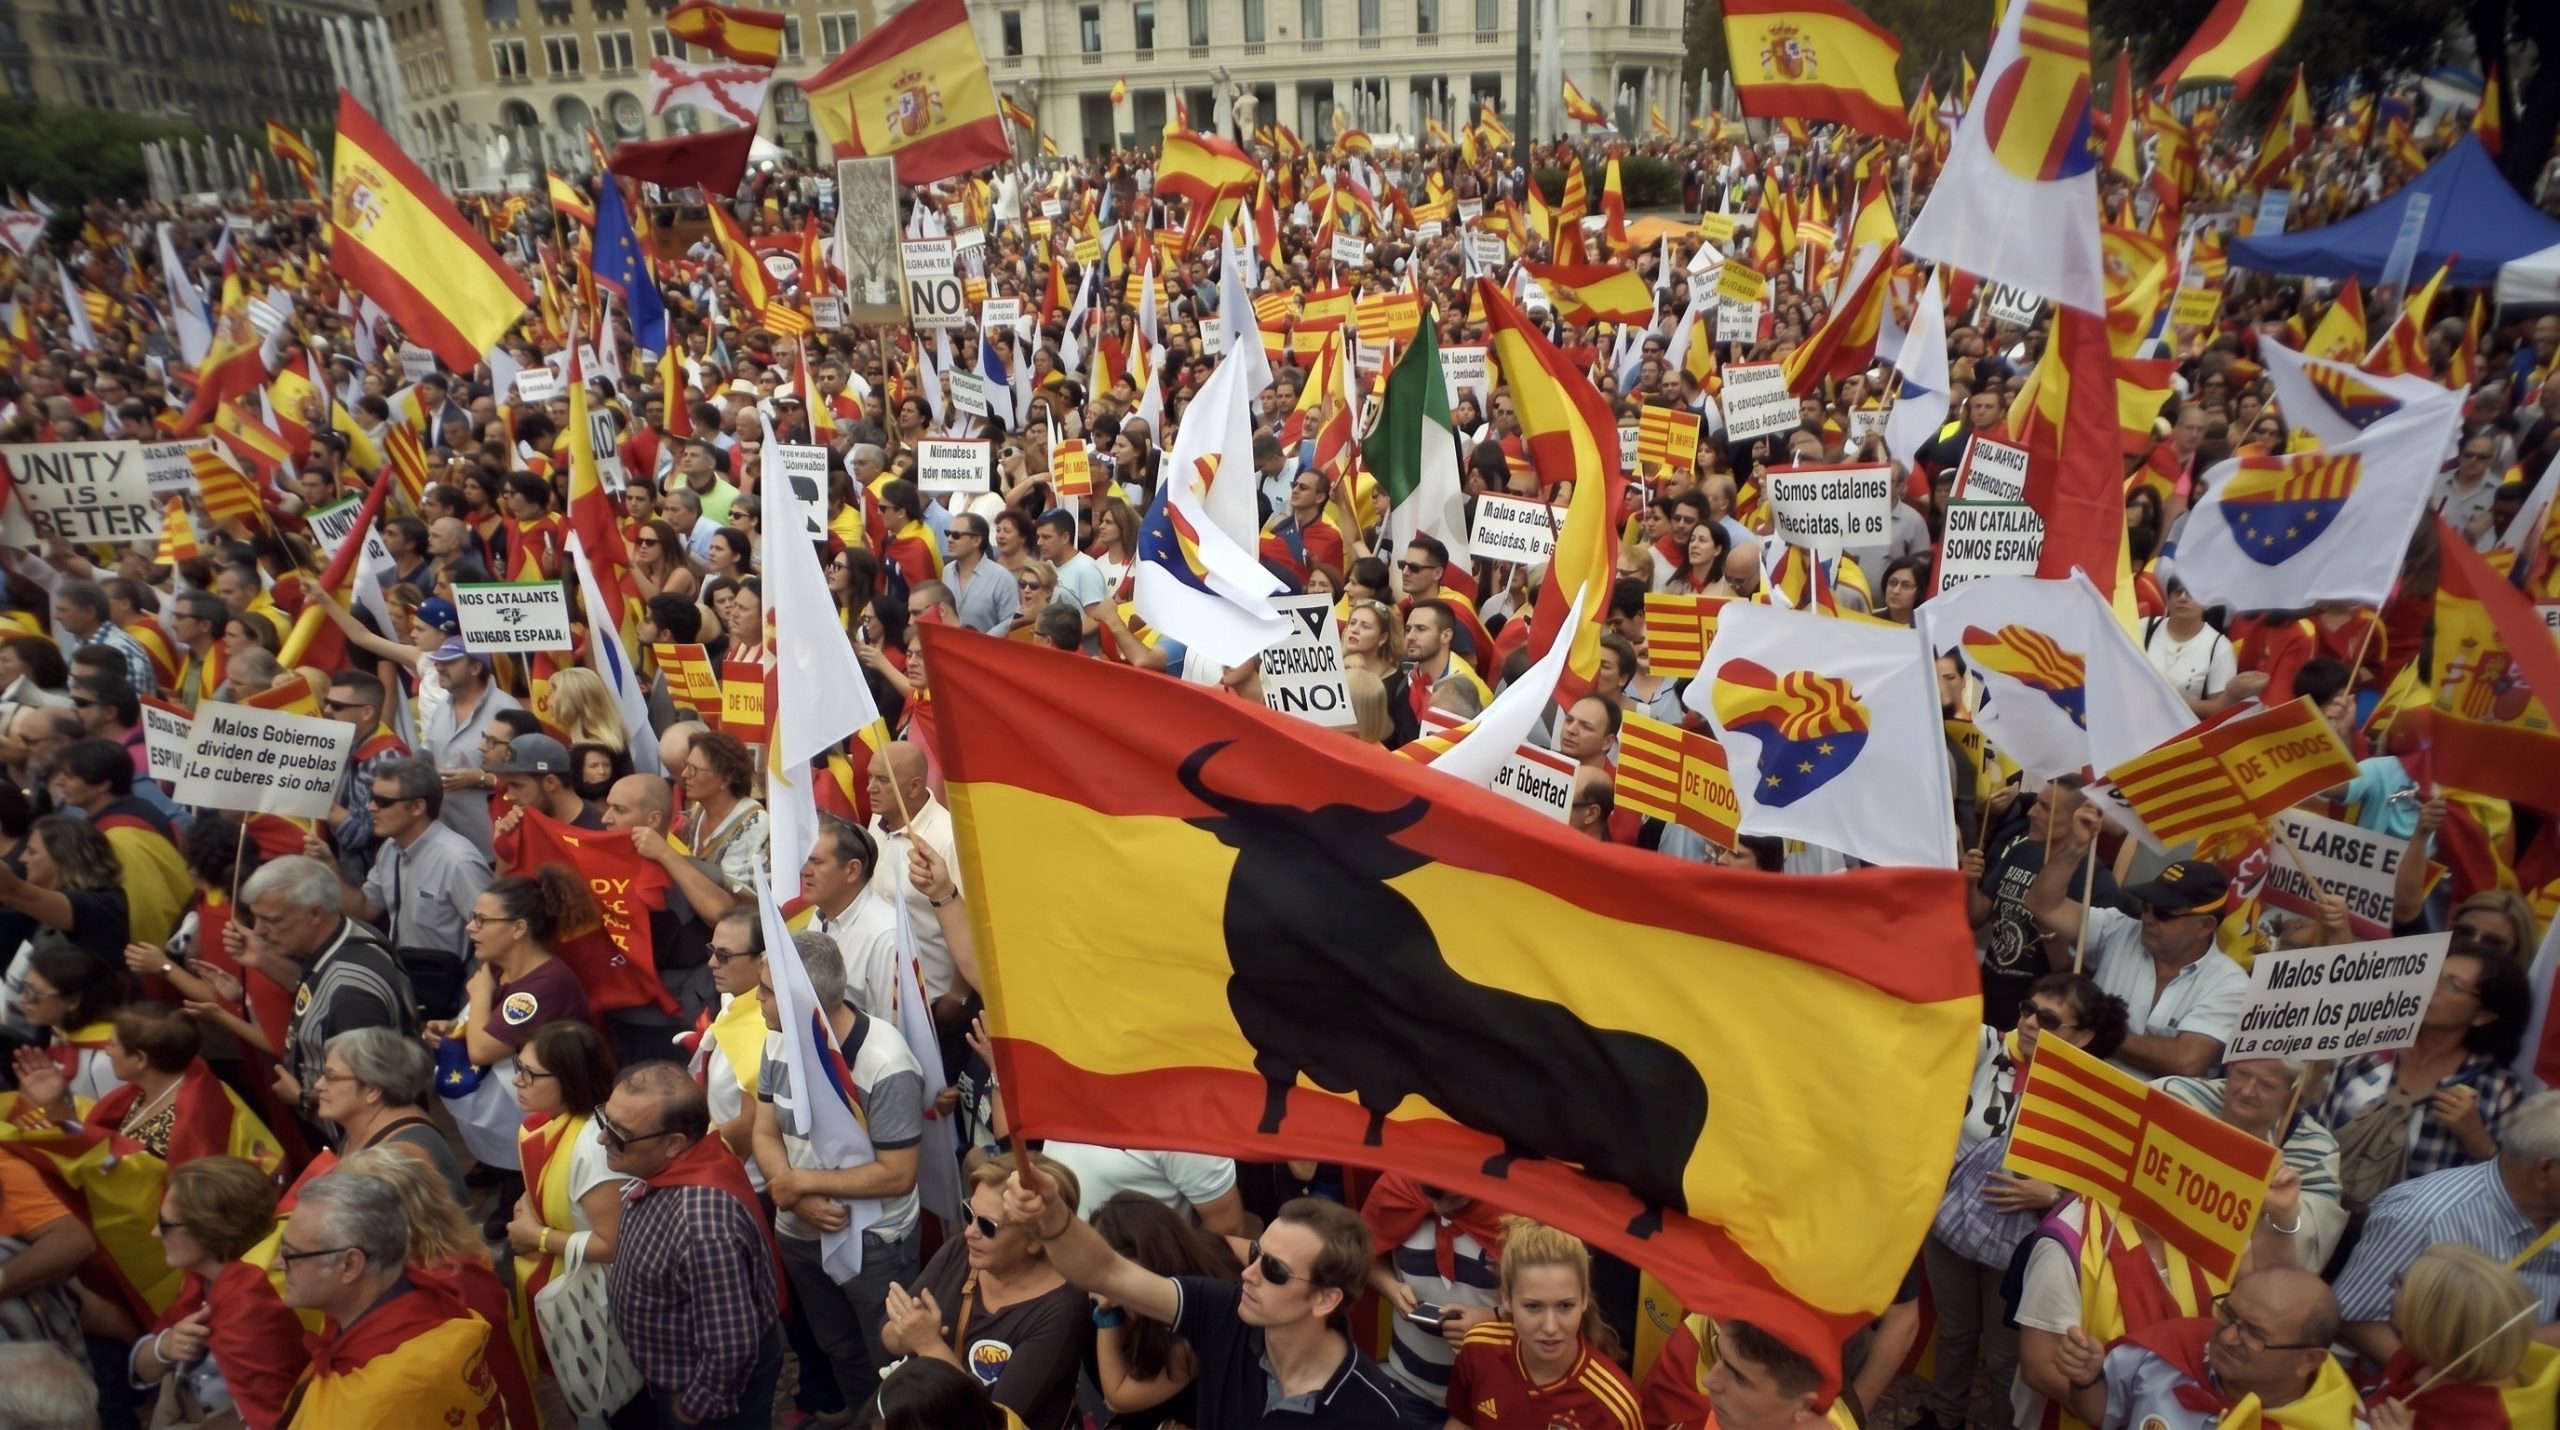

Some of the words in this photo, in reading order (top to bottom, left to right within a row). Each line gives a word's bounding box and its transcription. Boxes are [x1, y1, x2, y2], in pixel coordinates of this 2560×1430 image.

[911, 279, 961, 315] NO
[10, 450, 125, 485] UNITY
[64, 486, 97, 505] IS
[1774, 479, 1817, 501] Somos
[1821, 476, 1887, 501] catalanes
[1949, 510, 1978, 533] SON
[1946, 538, 1992, 561] SOMOS
[458, 592, 485, 606] NOS
[486, 590, 560, 605] CATALANTS
[212, 716, 259, 740] Malos
[262, 724, 337, 750] Gobiernos
[196, 740, 254, 762] dividen
[256, 747, 277, 765] de
[2234, 755, 2268, 785] DE
[2261, 731, 2334, 768] TODOS
[1685, 770, 1701, 796] DE
[2267, 958, 2325, 991] Malos
[2240, 1000, 2310, 1032] dividen
[2312, 997, 2344, 1027] los
[2344, 989, 2422, 1031] puebles
[2343, 1029, 2373, 1049] del
[2141, 1143, 2174, 1187] DE
[2175, 1162, 2253, 1232] TODOS
